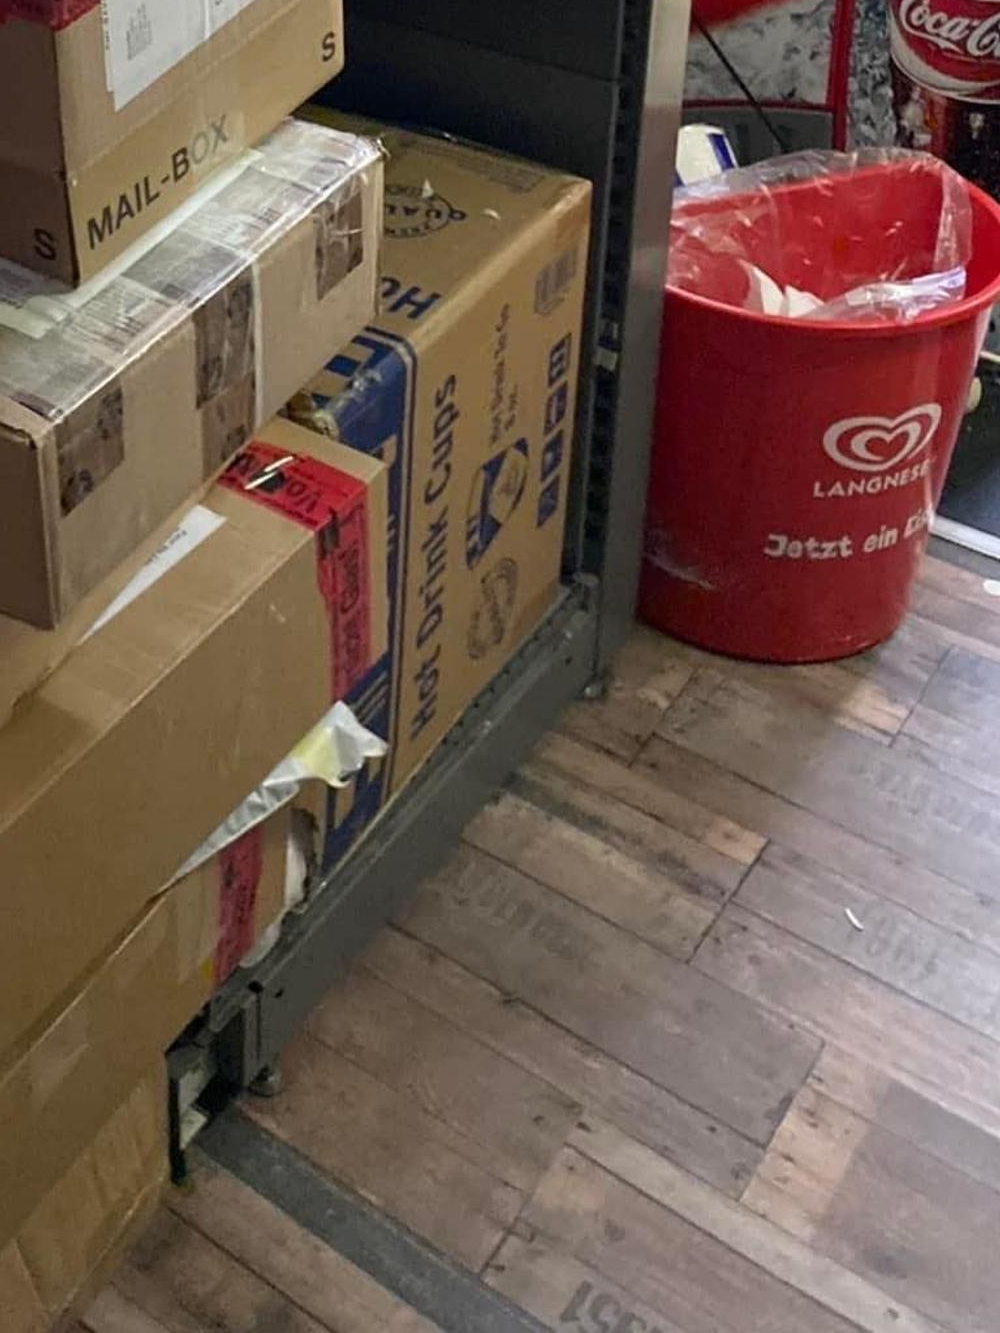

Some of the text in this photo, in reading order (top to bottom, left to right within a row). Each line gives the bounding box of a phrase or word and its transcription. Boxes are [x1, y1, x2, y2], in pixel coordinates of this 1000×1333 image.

[322, 31, 336, 63] S
[86, 114, 229, 250] MAIL-BOX
[33, 228, 57, 261] S
[812, 458, 932, 498] LANGNESE
[409, 373, 460, 742] Hot Drink Cups
[763, 533, 854, 560] Jetzt
[863, 524, 899, 554] ein
